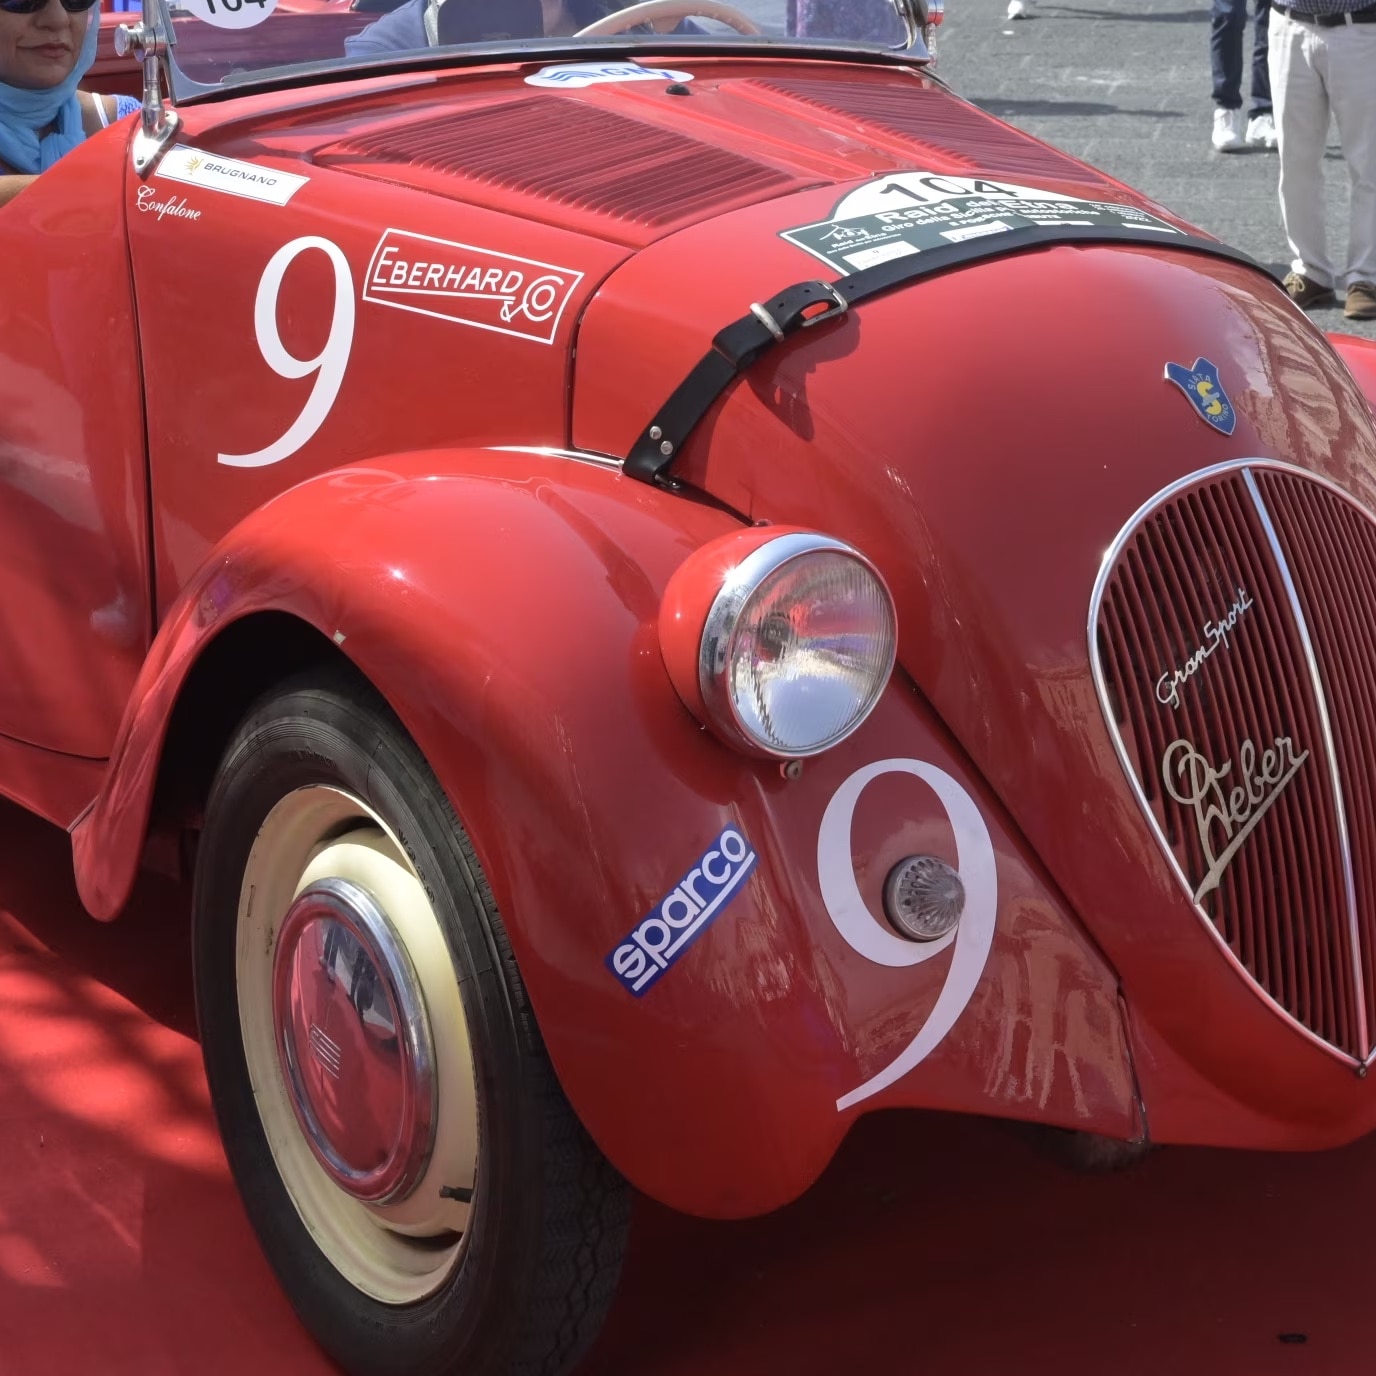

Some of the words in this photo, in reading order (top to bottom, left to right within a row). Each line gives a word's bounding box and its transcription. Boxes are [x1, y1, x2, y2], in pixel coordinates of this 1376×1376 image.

[203, 162, 277, 186] BRUGNANO
[879, 176, 1019, 202] 104
[135, 185, 202, 221] Confalone
[874, 202, 961, 224] Raid
[882, 221, 914, 232] Giro
[916, 214, 951, 226] della
[952, 206, 997, 220] Sicilia
[372, 246, 525, 294] EBERHARD
[217, 234, 356, 468] 9
[1187, 372, 1212, 391] SIATA
[1156, 648, 1210, 710] Gran
[1202, 587, 1254, 652] Sport
[613, 829, 747, 979] sparco
[816, 757, 999, 1113] 9
